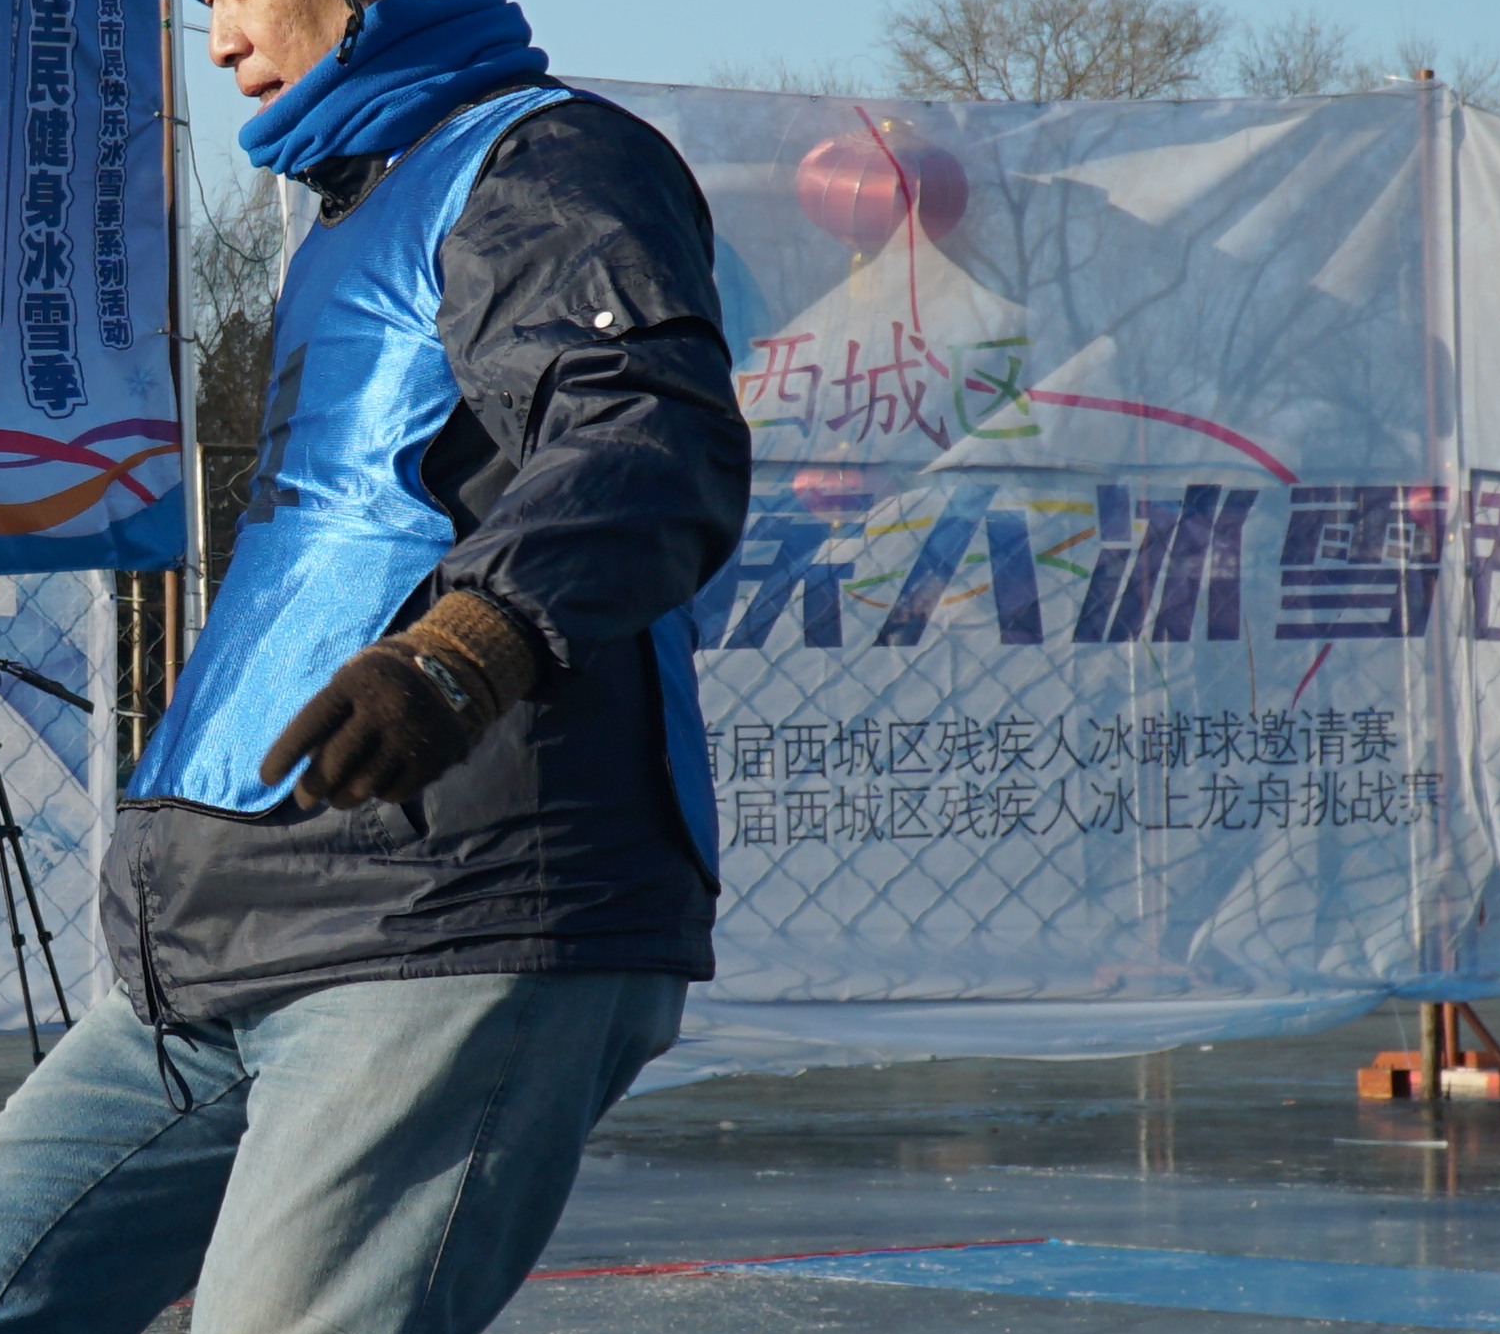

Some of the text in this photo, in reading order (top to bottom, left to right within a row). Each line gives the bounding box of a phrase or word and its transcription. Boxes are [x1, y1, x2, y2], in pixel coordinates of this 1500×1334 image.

[737, 321, 1044, 451] 西城区
[714, 768, 1448, 848] 届西城区残疾人冰上龙舟挑战赛
